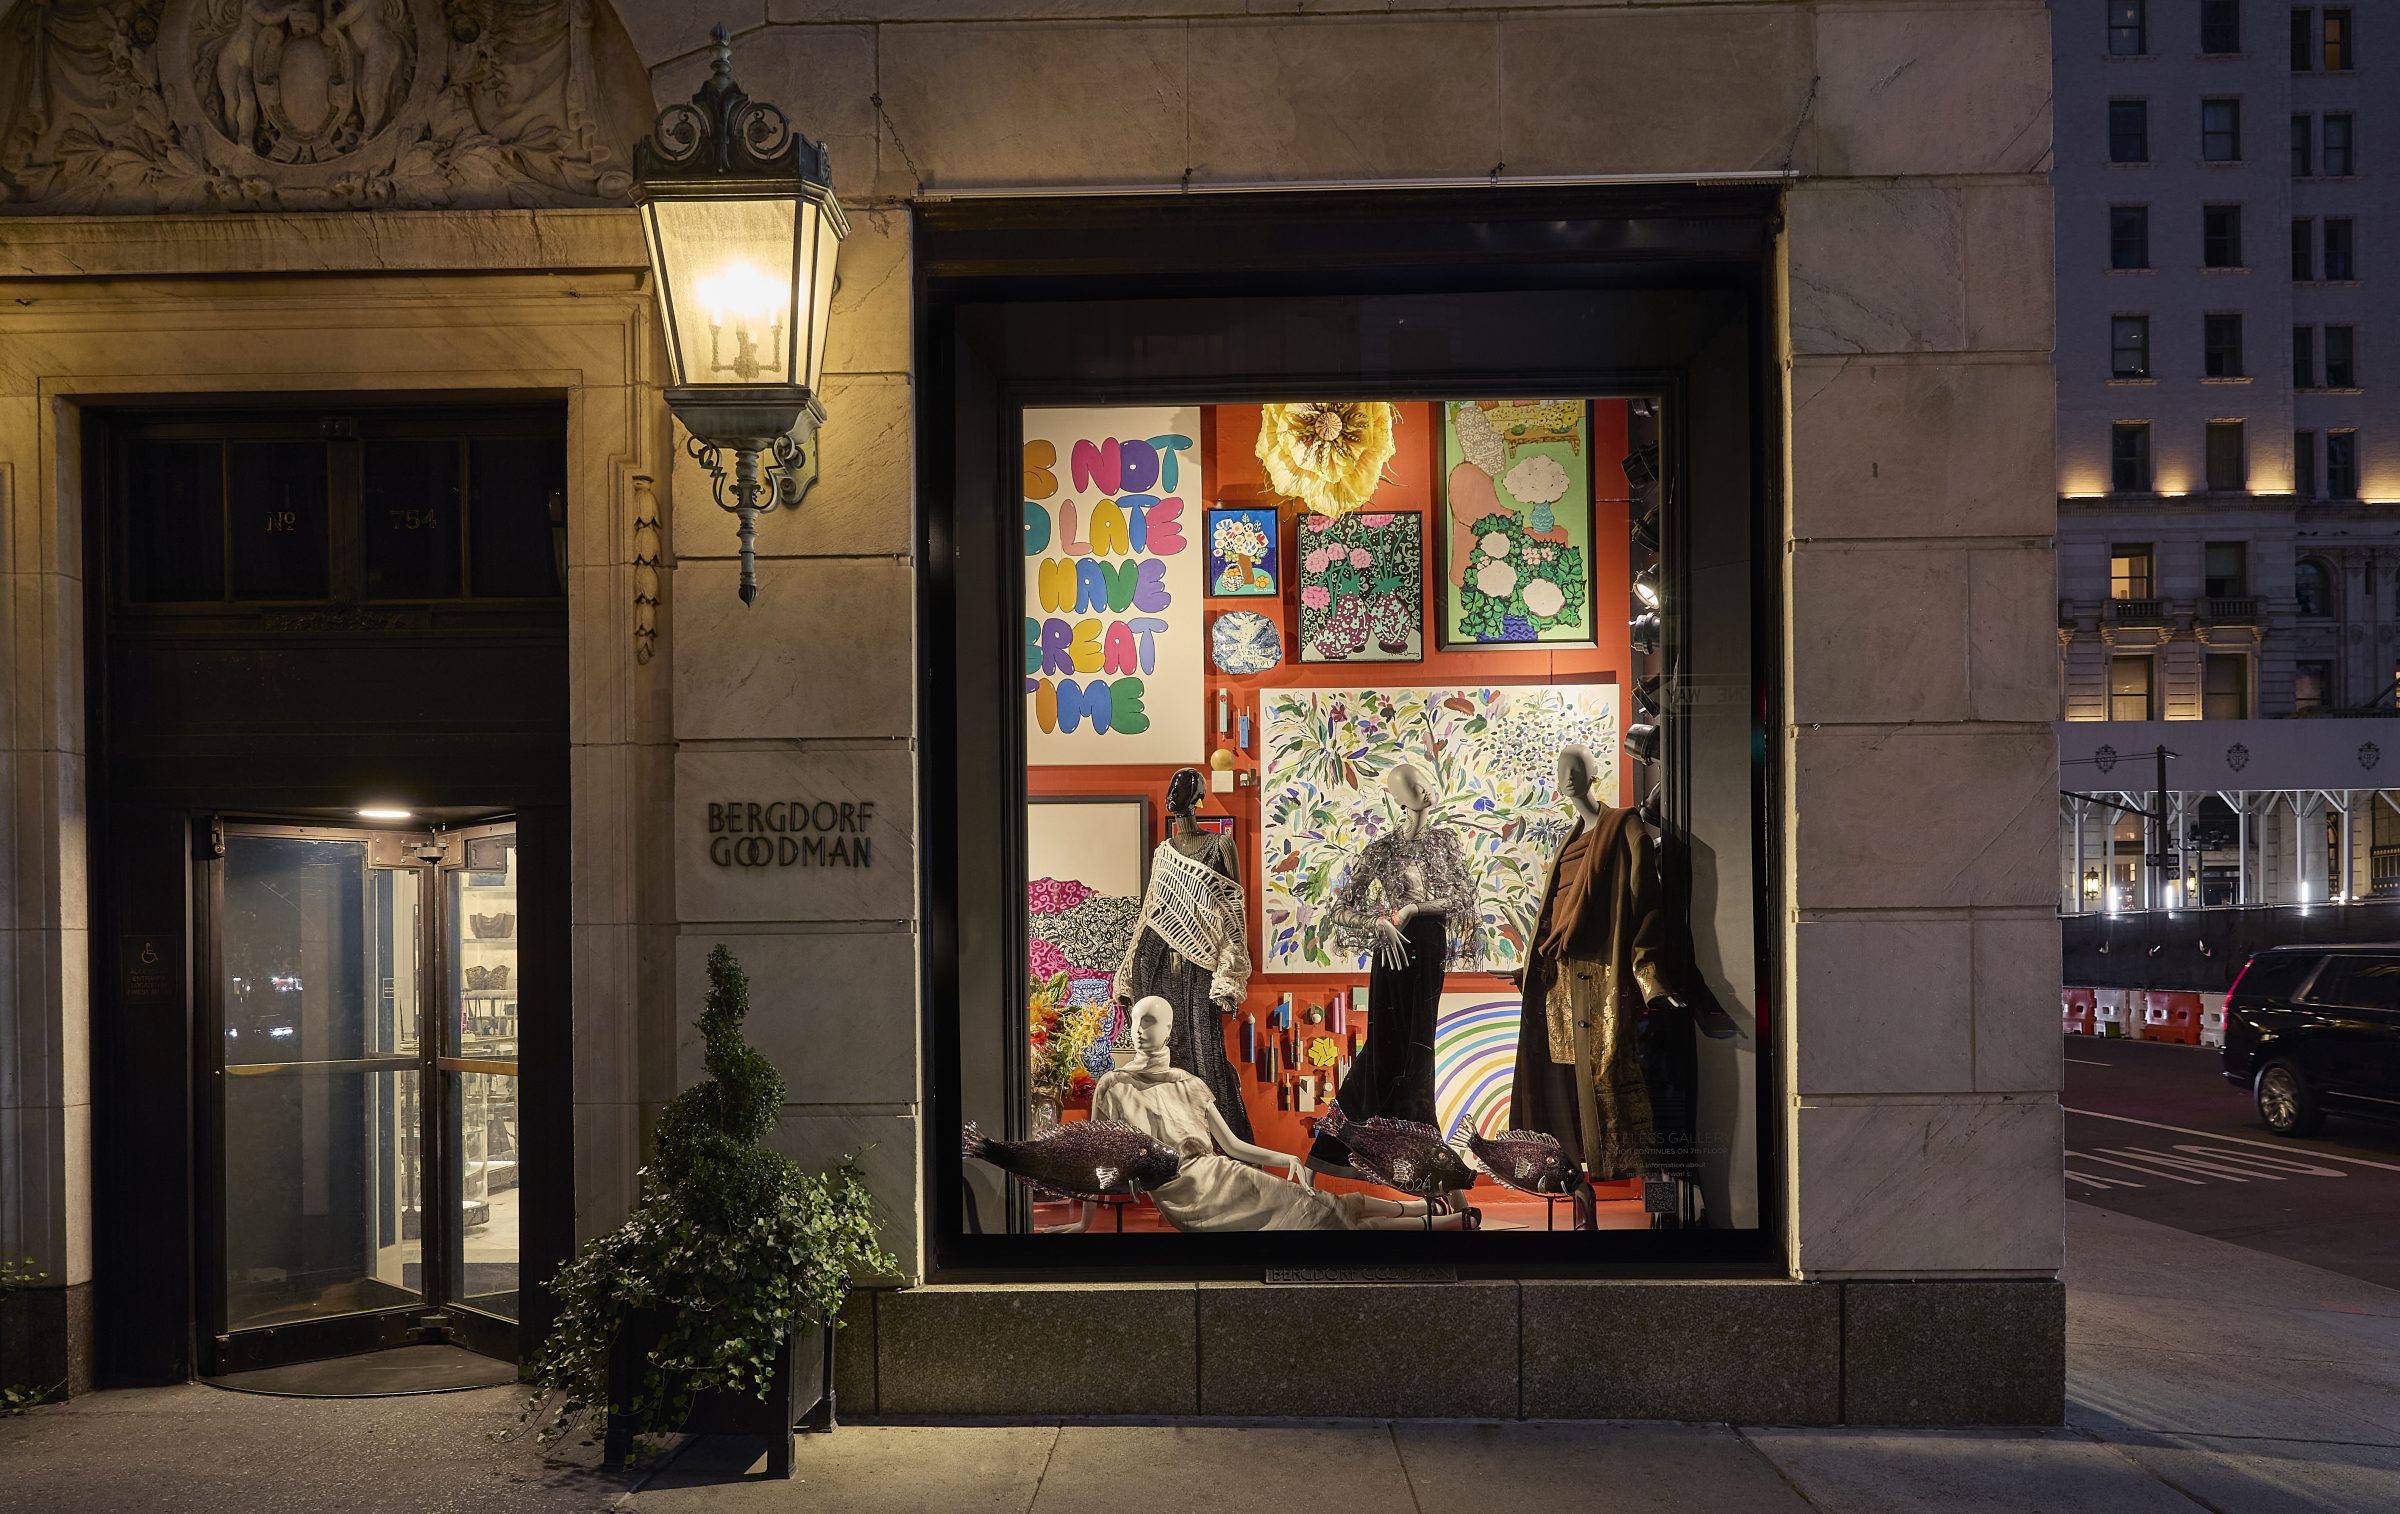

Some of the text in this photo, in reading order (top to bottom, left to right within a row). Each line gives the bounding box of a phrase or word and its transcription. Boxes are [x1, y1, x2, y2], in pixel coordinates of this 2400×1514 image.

[1071, 434, 1193, 496] NOT
[390, 508, 438, 529] 754
[1059, 494, 1187, 557] LATE
[1038, 557, 1171, 614] HAVE
[1026, 677, 1150, 735] IME
[708, 802, 874, 832] BERGDORF
[710, 835, 871, 867] GOODMAN
